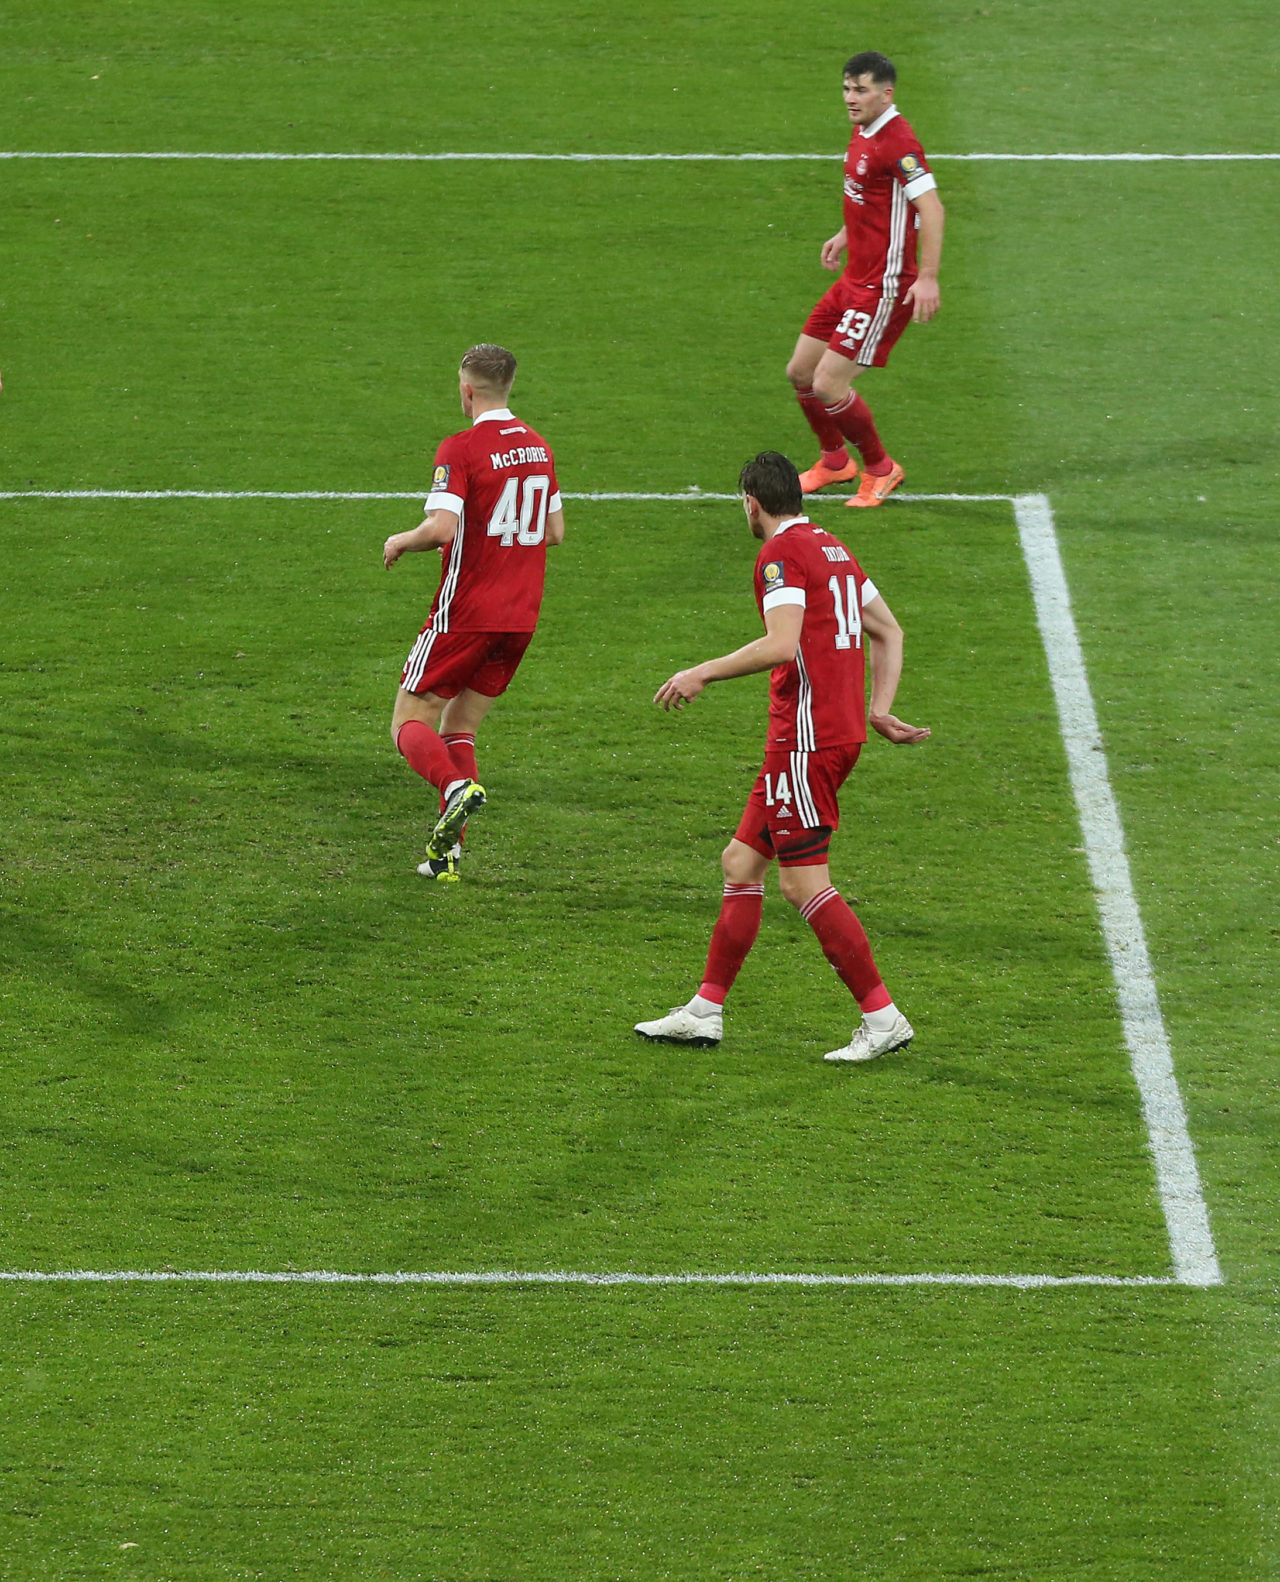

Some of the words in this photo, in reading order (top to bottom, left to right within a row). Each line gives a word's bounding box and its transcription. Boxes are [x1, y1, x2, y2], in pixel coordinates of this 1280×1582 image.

[835, 308, 872, 340] 33
[490, 446, 549, 470] McCRORIE
[487, 475, 550, 546] 40
[828, 575, 862, 650] 14
[765, 772, 792, 806] 14
